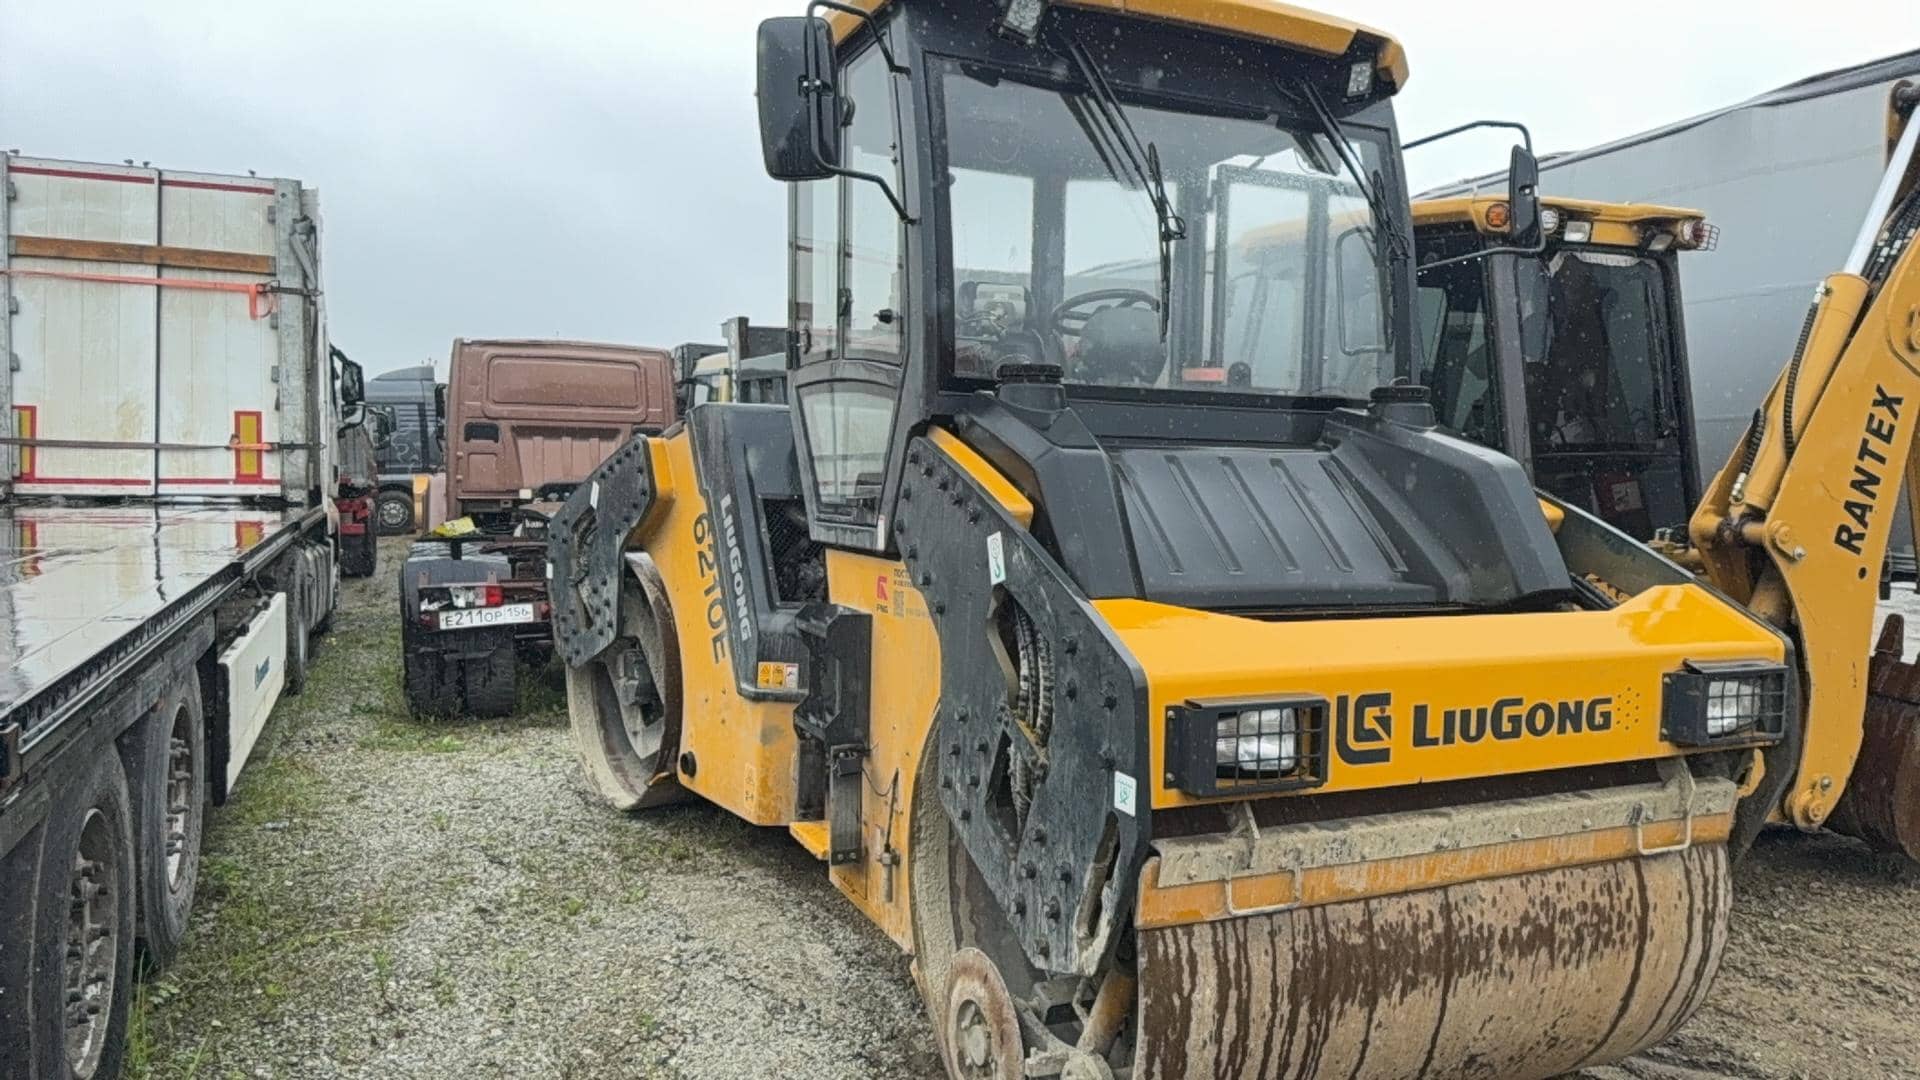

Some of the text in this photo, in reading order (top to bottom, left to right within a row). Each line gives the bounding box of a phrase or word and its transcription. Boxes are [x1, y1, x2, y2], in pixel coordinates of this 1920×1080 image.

[1834, 384, 1904, 555] RANTEX
[693, 512, 728, 664] 6210E
[720, 494, 751, 641] LIUGONG
